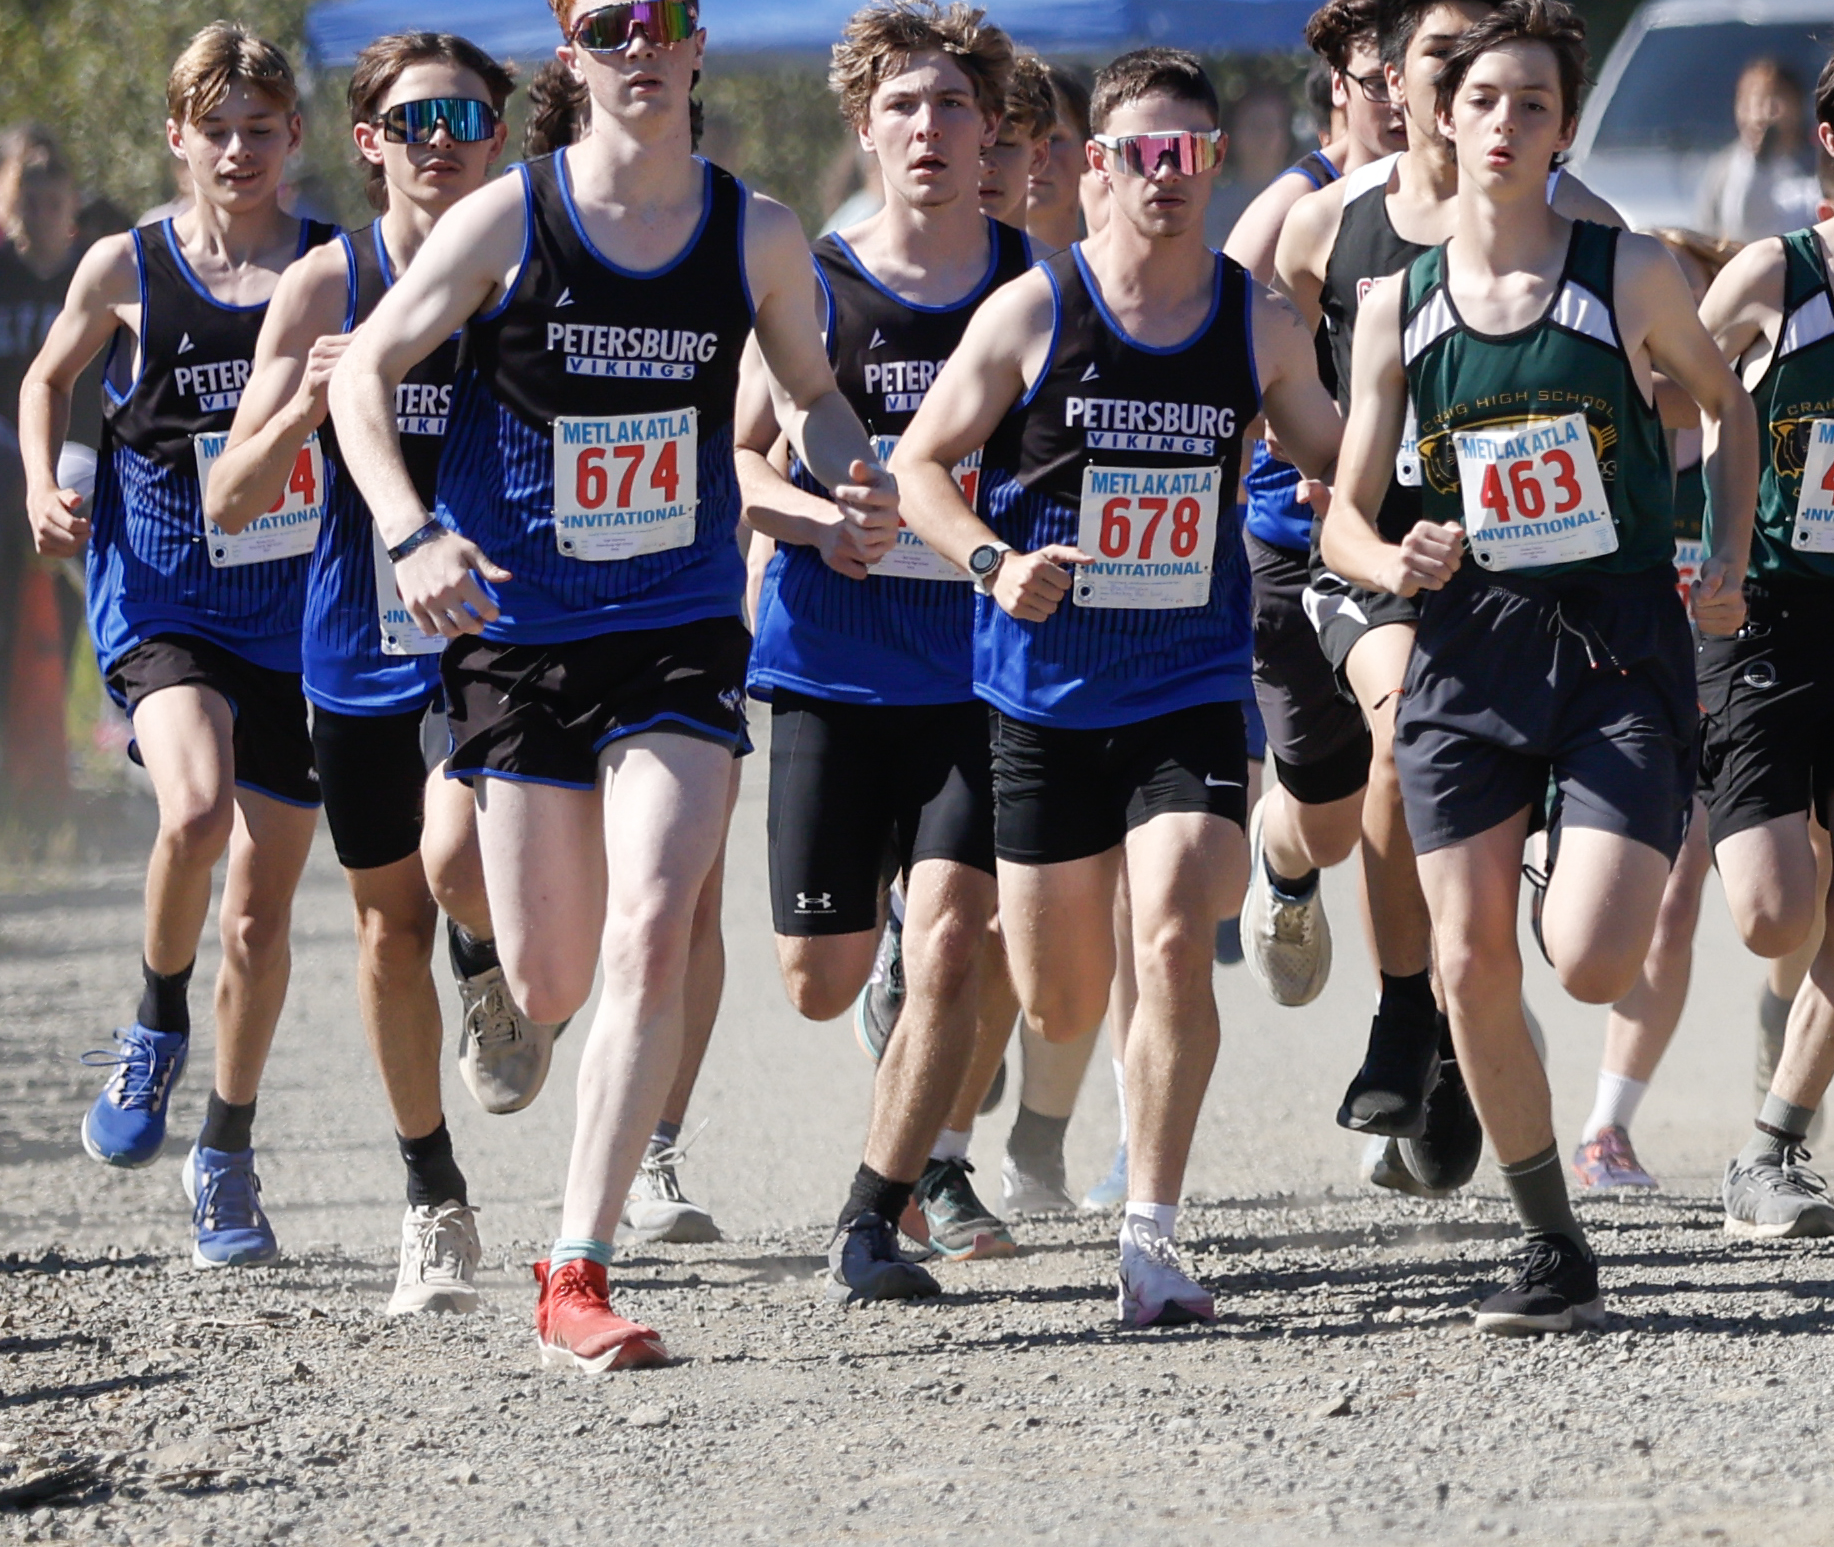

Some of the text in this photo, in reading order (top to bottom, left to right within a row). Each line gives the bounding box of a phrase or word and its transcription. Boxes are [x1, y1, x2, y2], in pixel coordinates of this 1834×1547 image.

[546, 321, 719, 364] PETERSBURG
[173, 358, 256, 397] PETER
[568, 357, 694, 380] VIKINGS
[863, 359, 947, 395] PETER
[562, 414, 691, 445] METLAKATLA
[1064, 396, 1237, 439] PETERSBURG
[1420, 402, 1469, 434] CRAIG
[1475, 389, 1529, 410] HIGH
[1088, 431, 1215, 456] VIKINGS
[1461, 421, 1580, 461] METLAKATLA
[575, 440, 680, 510] 674
[1090, 471, 1213, 496] METLAKATLA
[1479, 448, 1583, 523] 463
[562, 504, 688, 530] INVITATIONAL
[1098, 496, 1202, 561] 678
[1473, 510, 1601, 543] INVITATIONAL
[1083, 560, 1204, 578] INVITATIONAL
